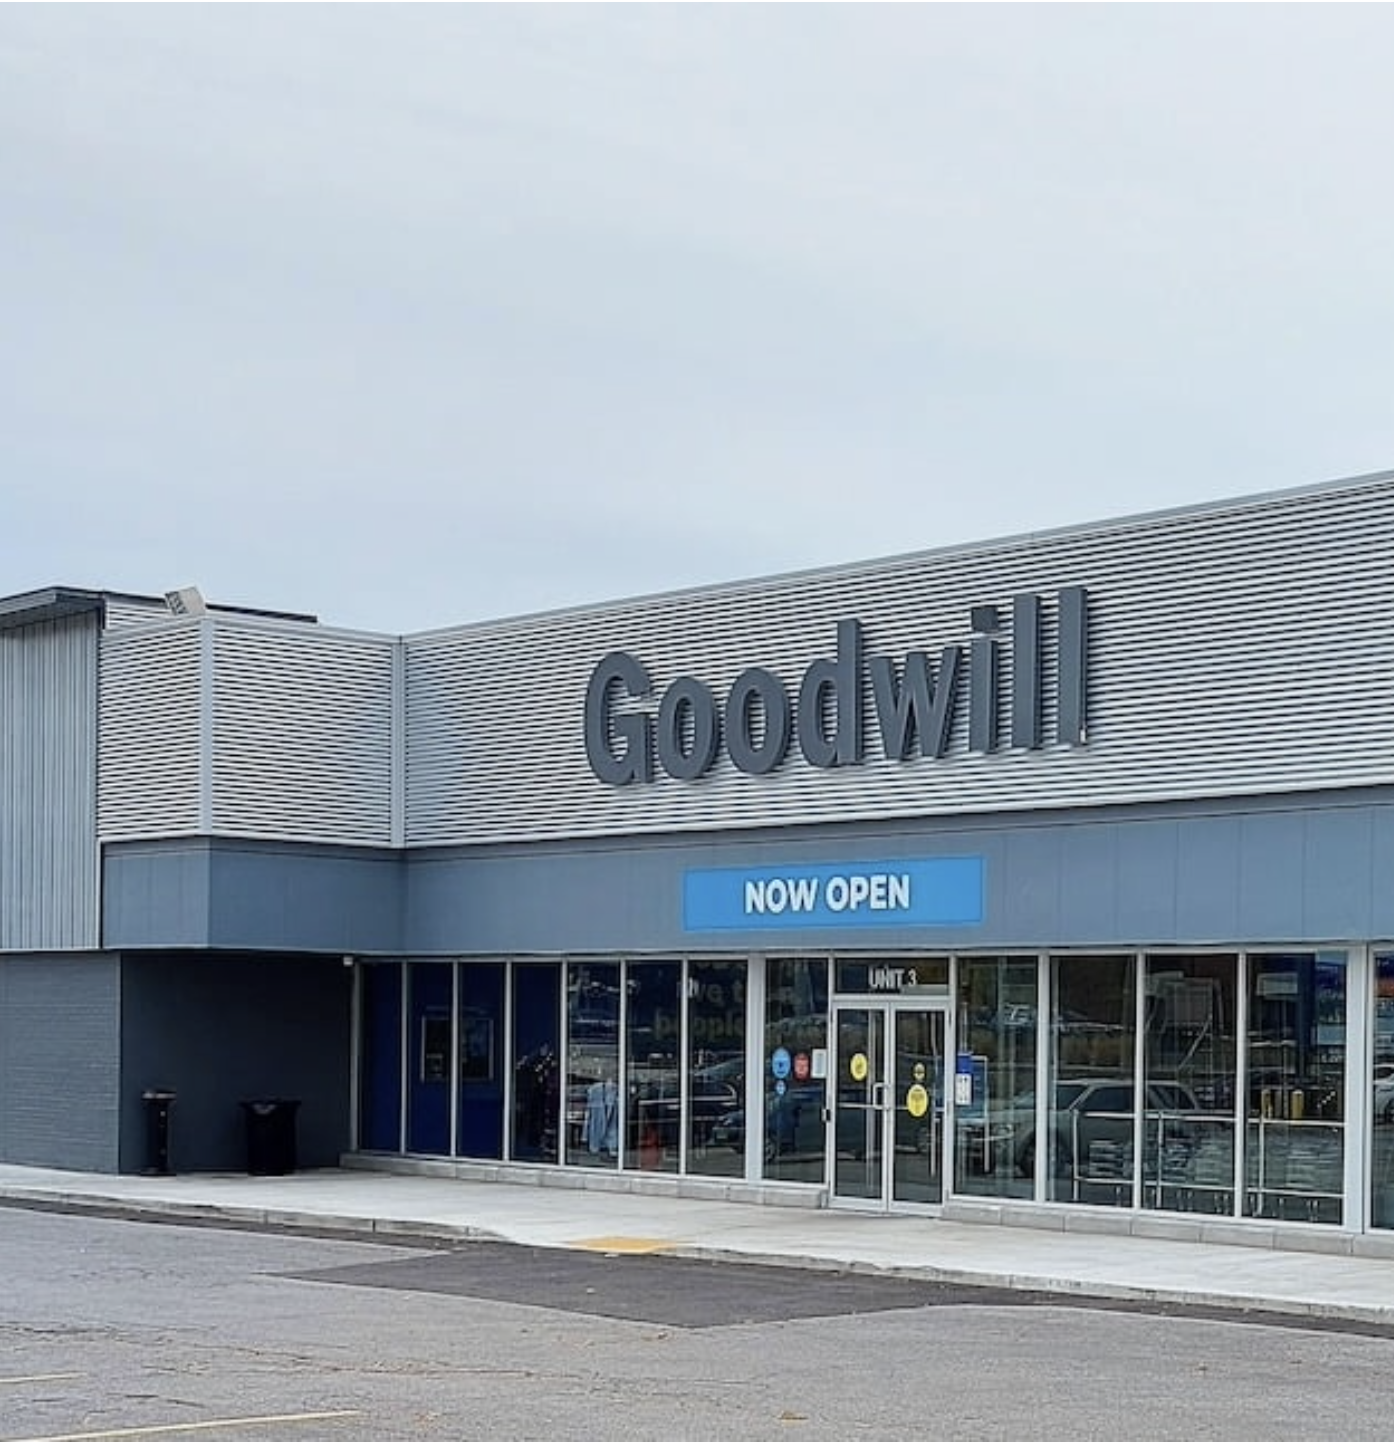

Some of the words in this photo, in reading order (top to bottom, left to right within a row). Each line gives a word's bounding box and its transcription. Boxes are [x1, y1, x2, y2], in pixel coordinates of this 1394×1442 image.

[583, 585, 1090, 786] Goodwill
[745, 879, 818, 913] NOW
[826, 874, 909, 911] OPEN
[868, 964, 905, 990] UNIT
[908, 968, 916, 987] 3
